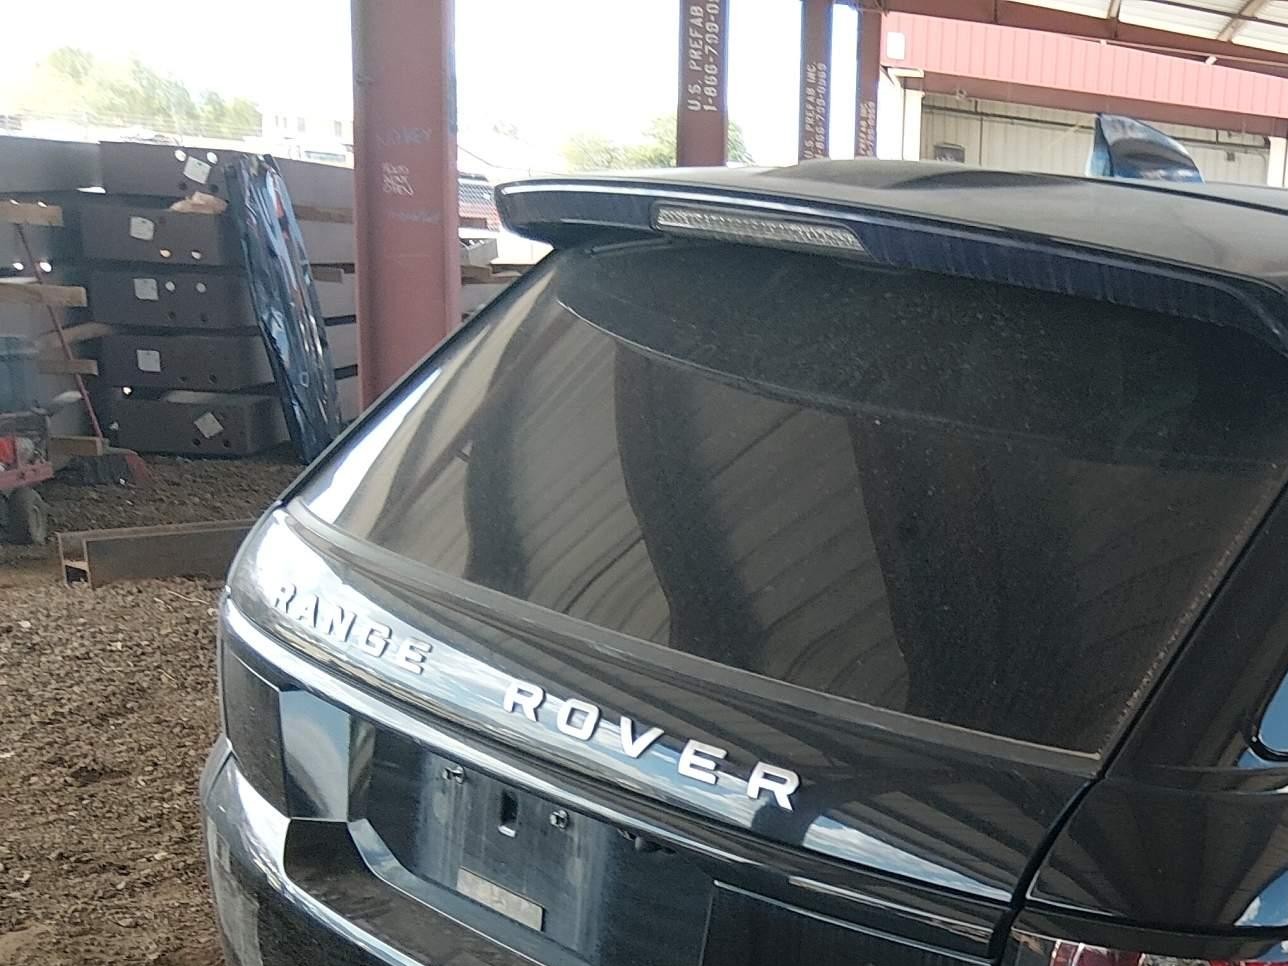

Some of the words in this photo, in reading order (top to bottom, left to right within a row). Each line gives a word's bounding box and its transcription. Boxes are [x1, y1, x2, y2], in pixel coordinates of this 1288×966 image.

[687, 5, 704, 71] PREFAB
[270, 582, 433, 675] RANGE
[502, 677, 801, 811] ROVER
